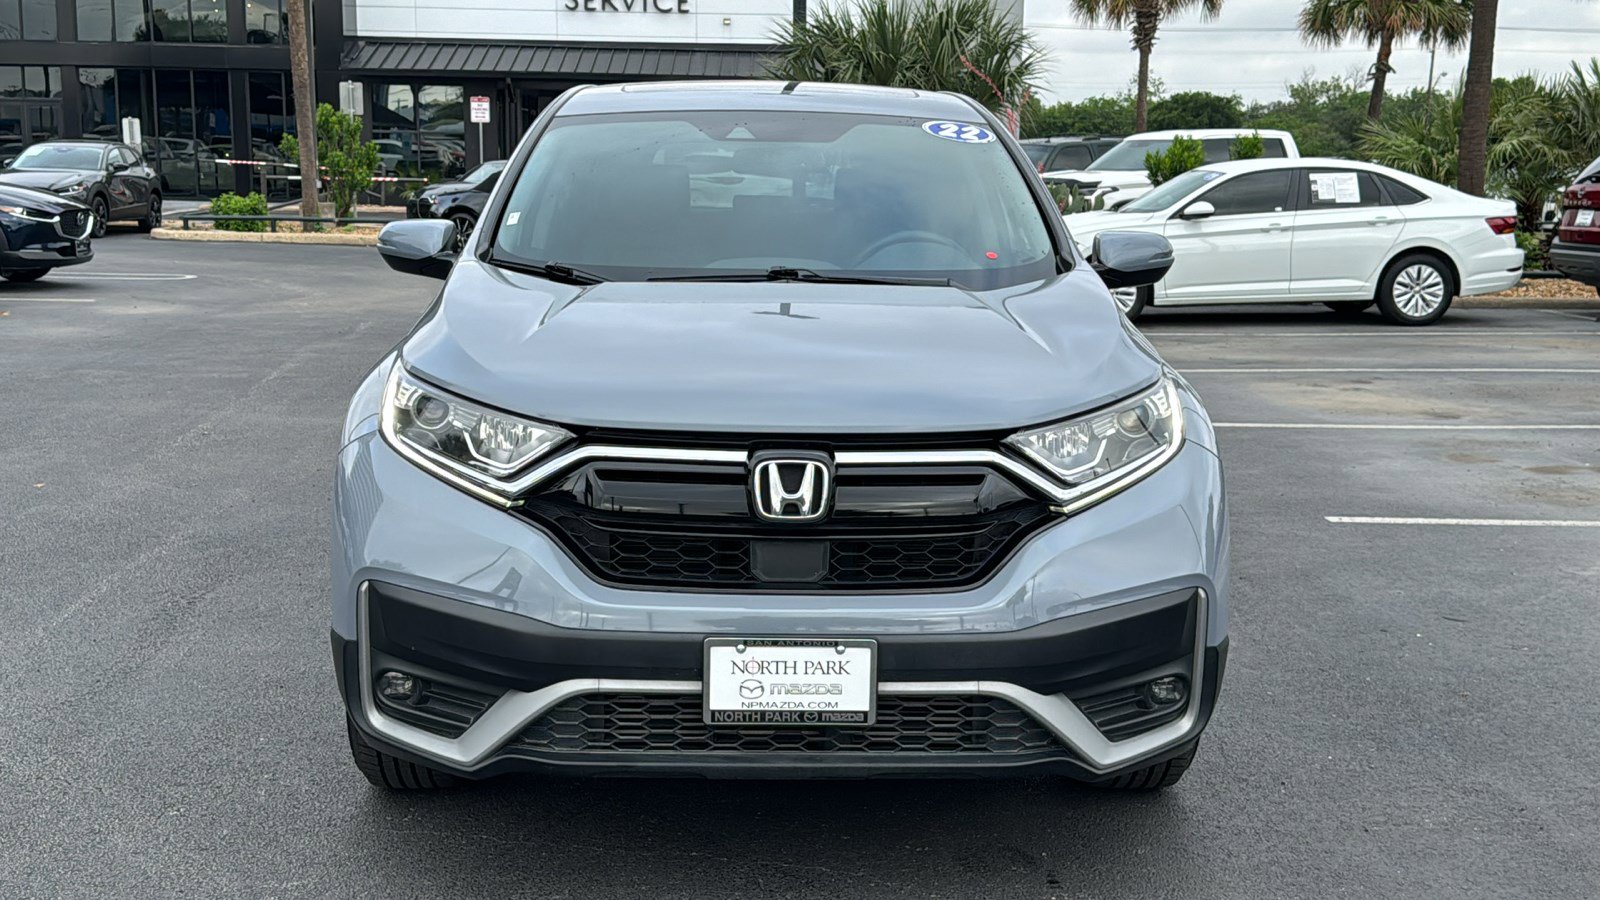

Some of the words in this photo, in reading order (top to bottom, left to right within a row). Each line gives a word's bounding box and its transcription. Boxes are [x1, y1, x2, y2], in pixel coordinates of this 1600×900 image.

[565, 0, 690, 13] SERVICE
[938, 123, 980, 140] 22
[731, 659, 798, 675] NORTH
[804, 660, 851, 675] PARK
[770, 683, 843, 695] mazda
[741, 701, 839, 709] NPMAZDA.COM
[714, 711, 761, 722] NORTH
[765, 711, 801, 722] PARK
[821, 712, 865, 722] mazda
